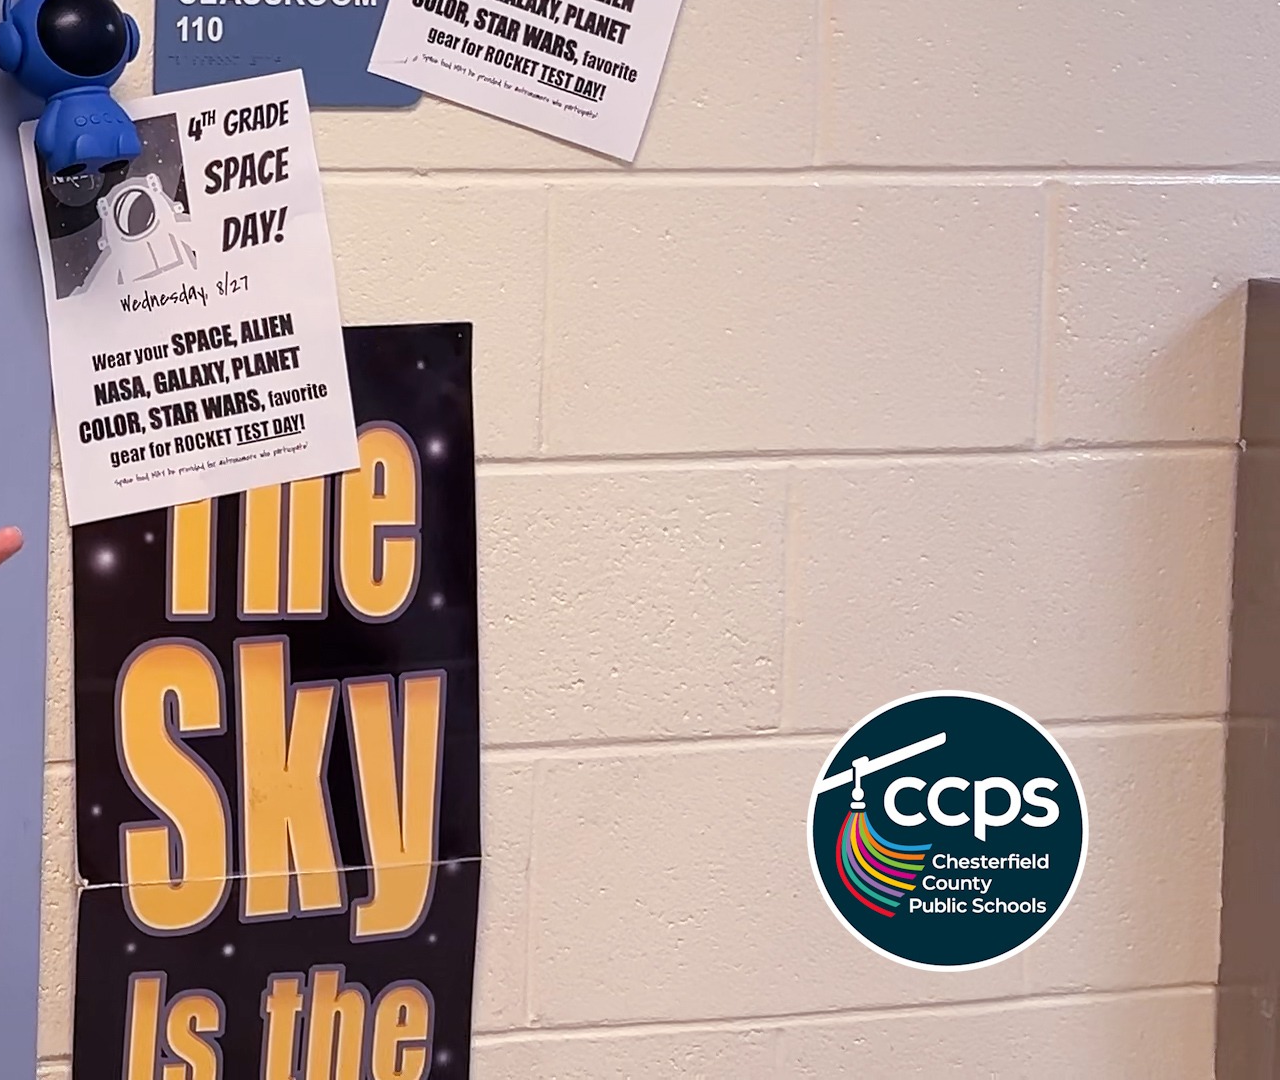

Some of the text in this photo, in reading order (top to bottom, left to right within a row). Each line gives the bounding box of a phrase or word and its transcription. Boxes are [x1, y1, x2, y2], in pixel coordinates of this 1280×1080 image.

[176, 15, 224, 43] 110
[474, 8, 521, 42] STAR
[522, 24, 578, 65] WARS,
[582, 51, 638, 83] favorite
[563, 3, 631, 45] PLANET
[427, 28, 607, 101] gear for ROCKET TEST DAY!
[223, 100, 289, 136] GRADE
[204, 146, 289, 195] SPACE
[222, 206, 288, 252] DAY!
[120, 271, 249, 312] Wednesday, 8/27
[92, 313, 294, 371] Wear your SPACE, ALIEN
[93, 346, 300, 406] NASA, GALAXY, PLANET
[79, 383, 328, 444] COLOR, STAR WARS, favorite
[110, 413, 305, 468] gear for ROCKET TEST DAY!
[115, 635, 448, 944] Sky
[126, 963, 434, 1080] Is the
